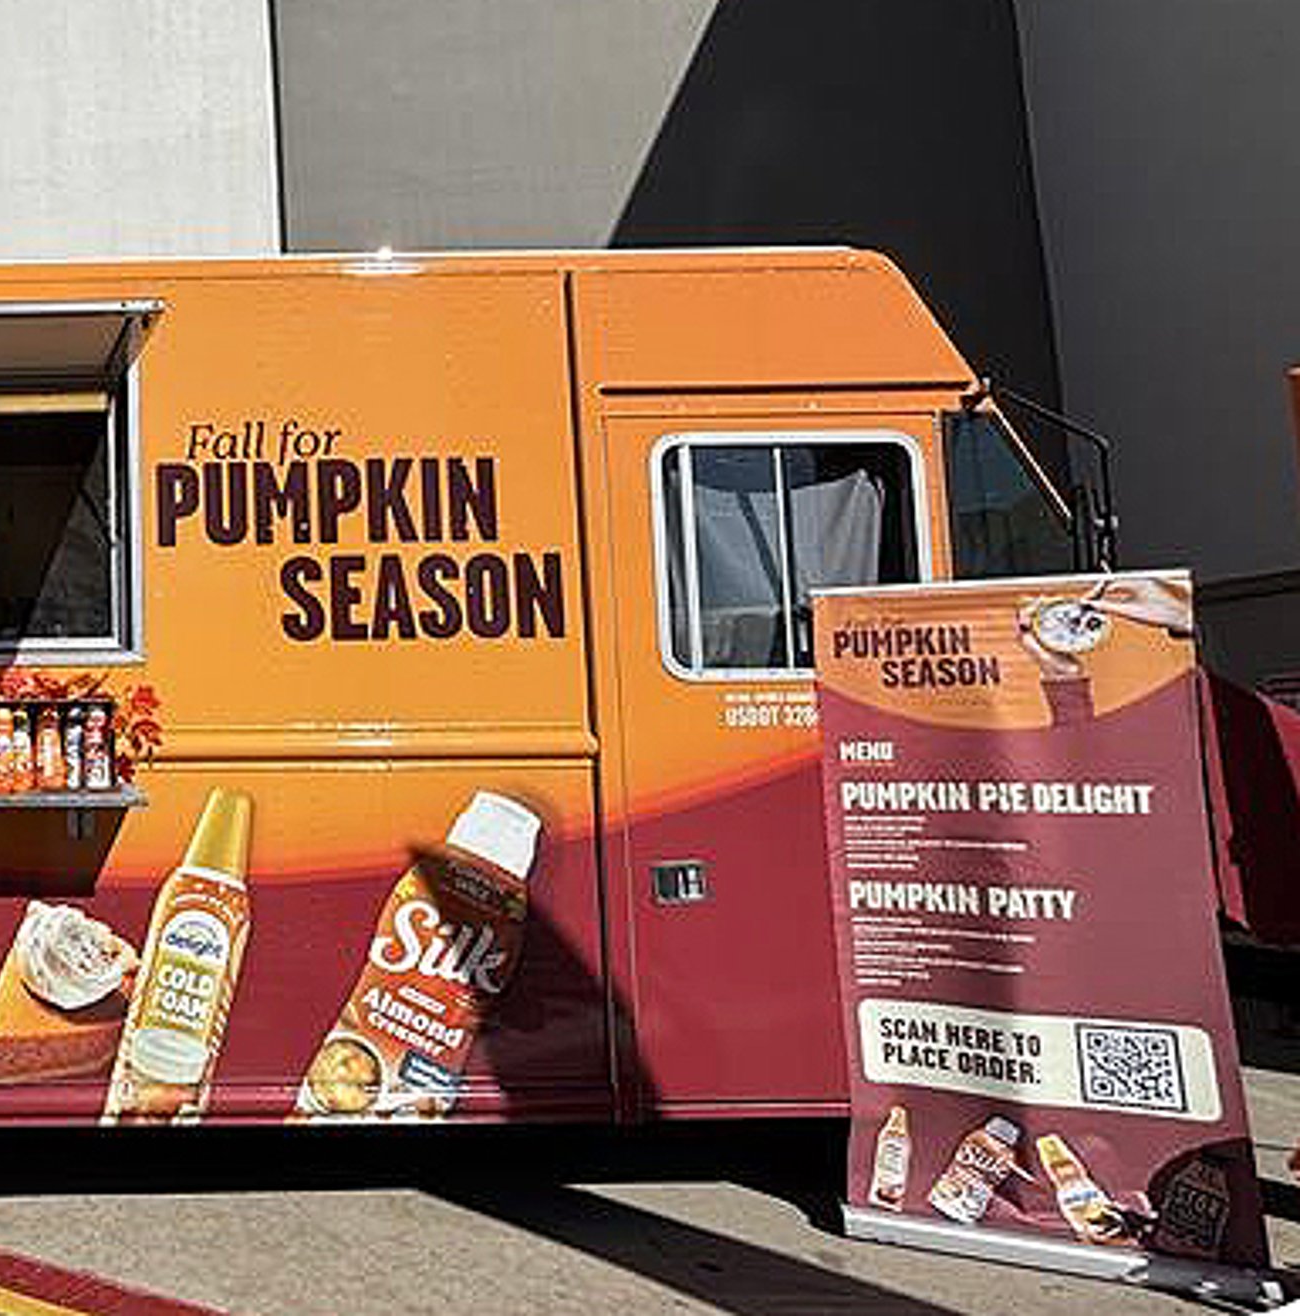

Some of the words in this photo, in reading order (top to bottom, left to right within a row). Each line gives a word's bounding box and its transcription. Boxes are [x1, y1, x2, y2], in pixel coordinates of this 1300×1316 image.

[186, 420, 265, 461] Fall
[277, 420, 342, 465] for
[155, 456, 499, 547] PUMPKIN
[279, 552, 565, 641] SEASON
[833, 625, 970, 659] PUMPKIN
[881, 656, 1000, 688] SEASON
[839, 742, 894, 762] MENU
[840, 782, 970, 811] PUMPKIN
[978, 783, 1029, 812] PIE
[1033, 784, 1154, 814] DELIGHT
[848, 880, 980, 917] PUMPKIN
[988, 886, 1078, 921] PATTY
[369, 900, 506, 993] Silk
[158, 964, 214, 999] COLD
[361, 987, 464, 1050] Almond
[879, 1017, 938, 1042] SCAN
[944, 1022, 1005, 1053] HERE
[1012, 1031, 1041, 1057] TO
[882, 1041, 951, 1071] PLACE
[957, 1051, 1042, 1086] ORDER.
